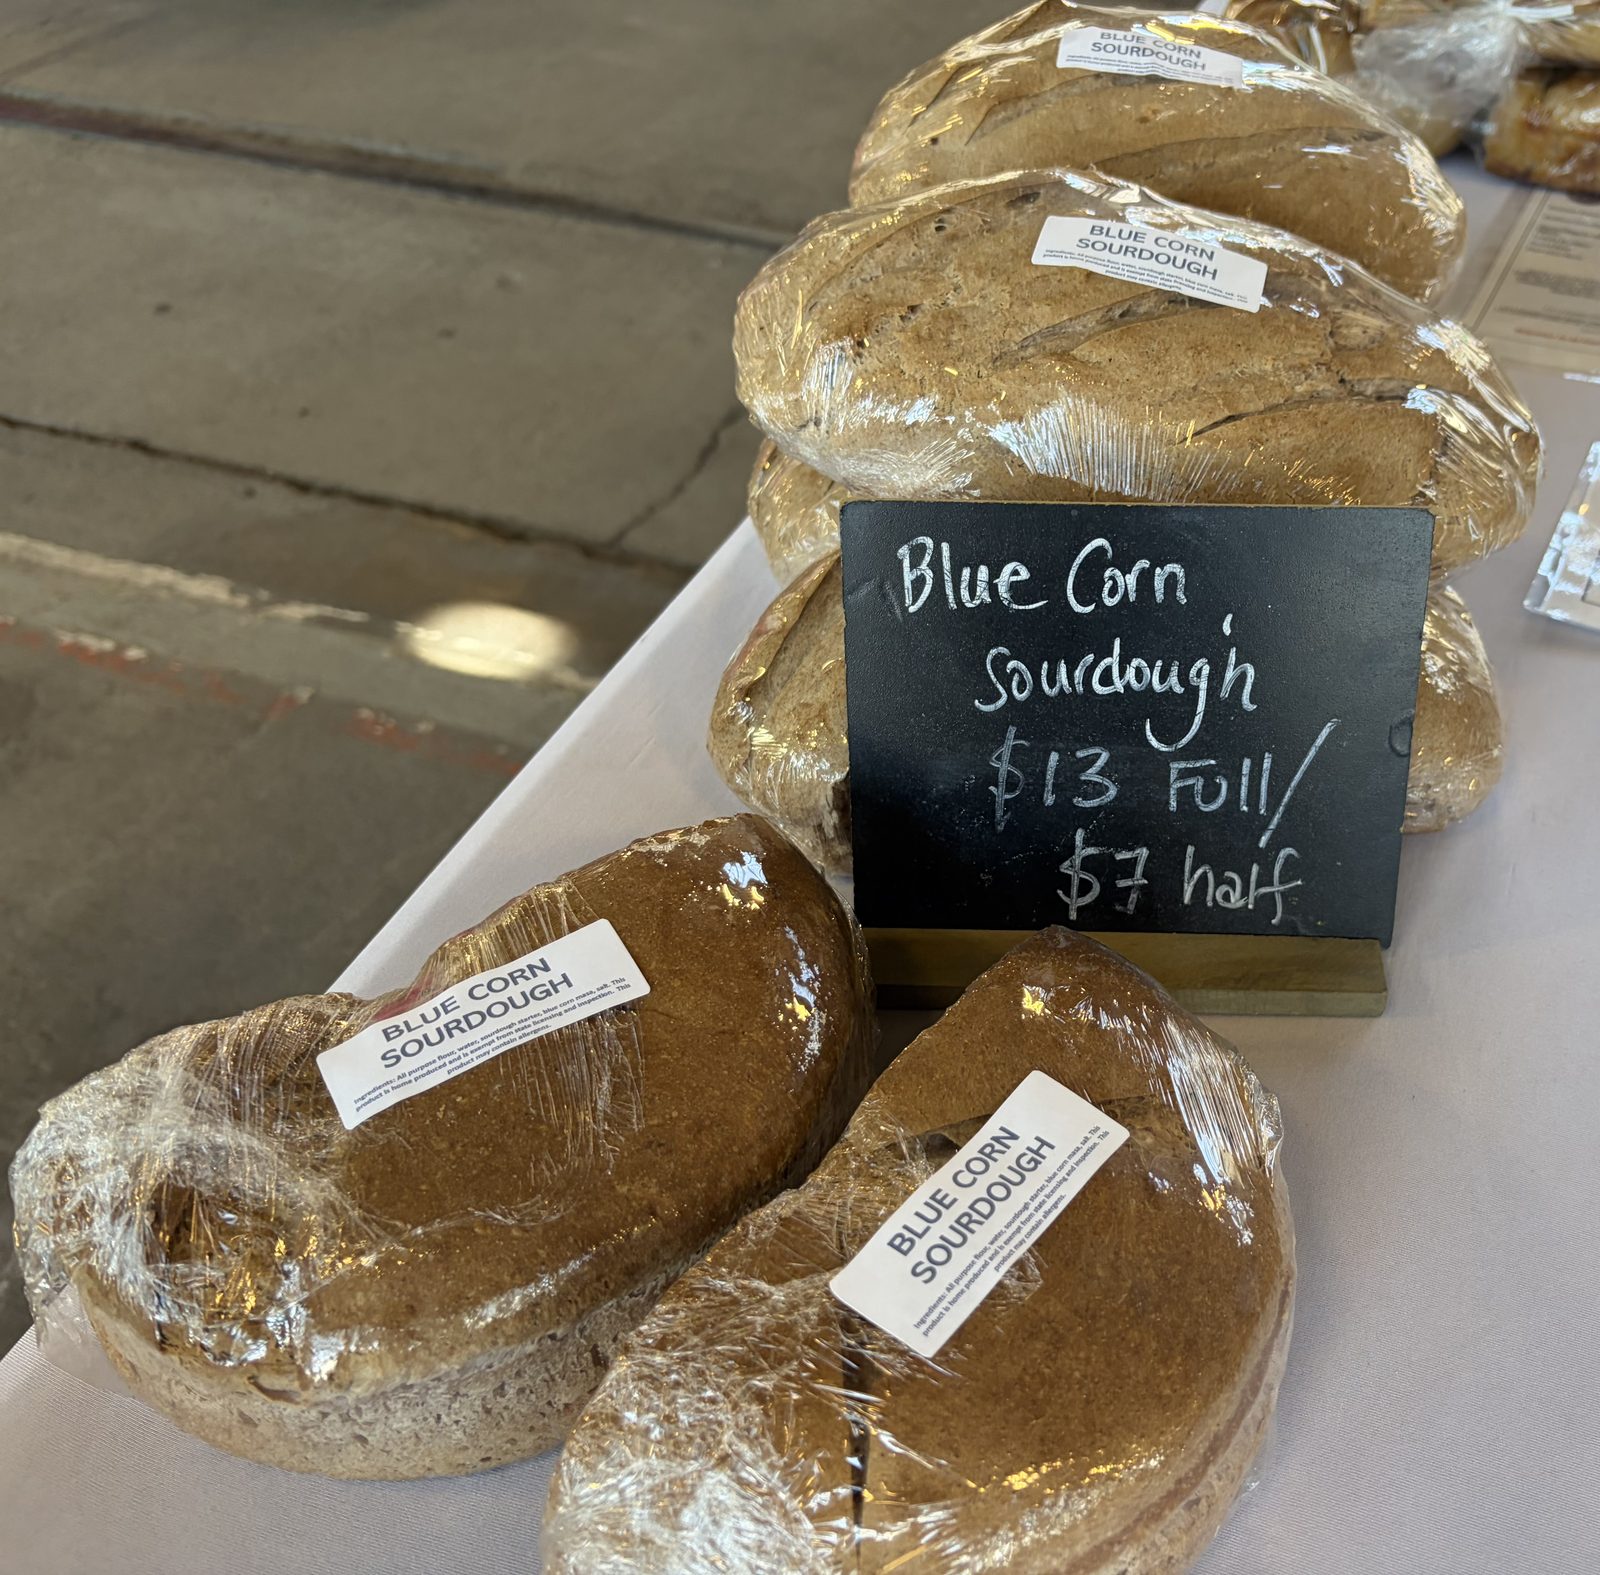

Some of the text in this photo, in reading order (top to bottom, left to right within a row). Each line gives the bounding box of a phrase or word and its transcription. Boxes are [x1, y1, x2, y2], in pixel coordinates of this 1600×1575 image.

[1091, 42, 1207, 71] SOURDOUGH
[1100, 32, 1202, 59] BLUE CORN
[1076, 238, 1218, 280] SOURDOUGH
[1089, 224, 1215, 261] BLUE CORN
[897, 535, 1187, 614] Blue Corn
[988, 726, 1119, 832] $13
[1057, 828, 1302, 926] $7 half
[353, 977, 626, 1104] Ingredients: All purpose flour, water, sourdough starter, blue corn masa, salt. This
[380, 972, 574, 1068] SOURDOUGH
[382, 957, 552, 1043] BLUE CORN
[356, 1092, 386, 1112] product
[391, 1079, 413, 1091] home
[414, 1062, 447, 1082] produced
[448, 1055, 461, 1065] and
[470, 1039, 495, 1054] exempt
[496, 1030, 514, 1041] from
[514, 1023, 532, 1033] state
[532, 1011, 563, 1026] licensing
[563, 1004, 577, 1014] and
[577, 989, 615, 1008] inspection.
[616, 983, 631, 992] This
[447, 1024, 552, 1075] product may contain allergens.
[887, 1125, 1021, 1257] BLUE CORN
[911, 1136, 1056, 1284] SOURDOUGH
